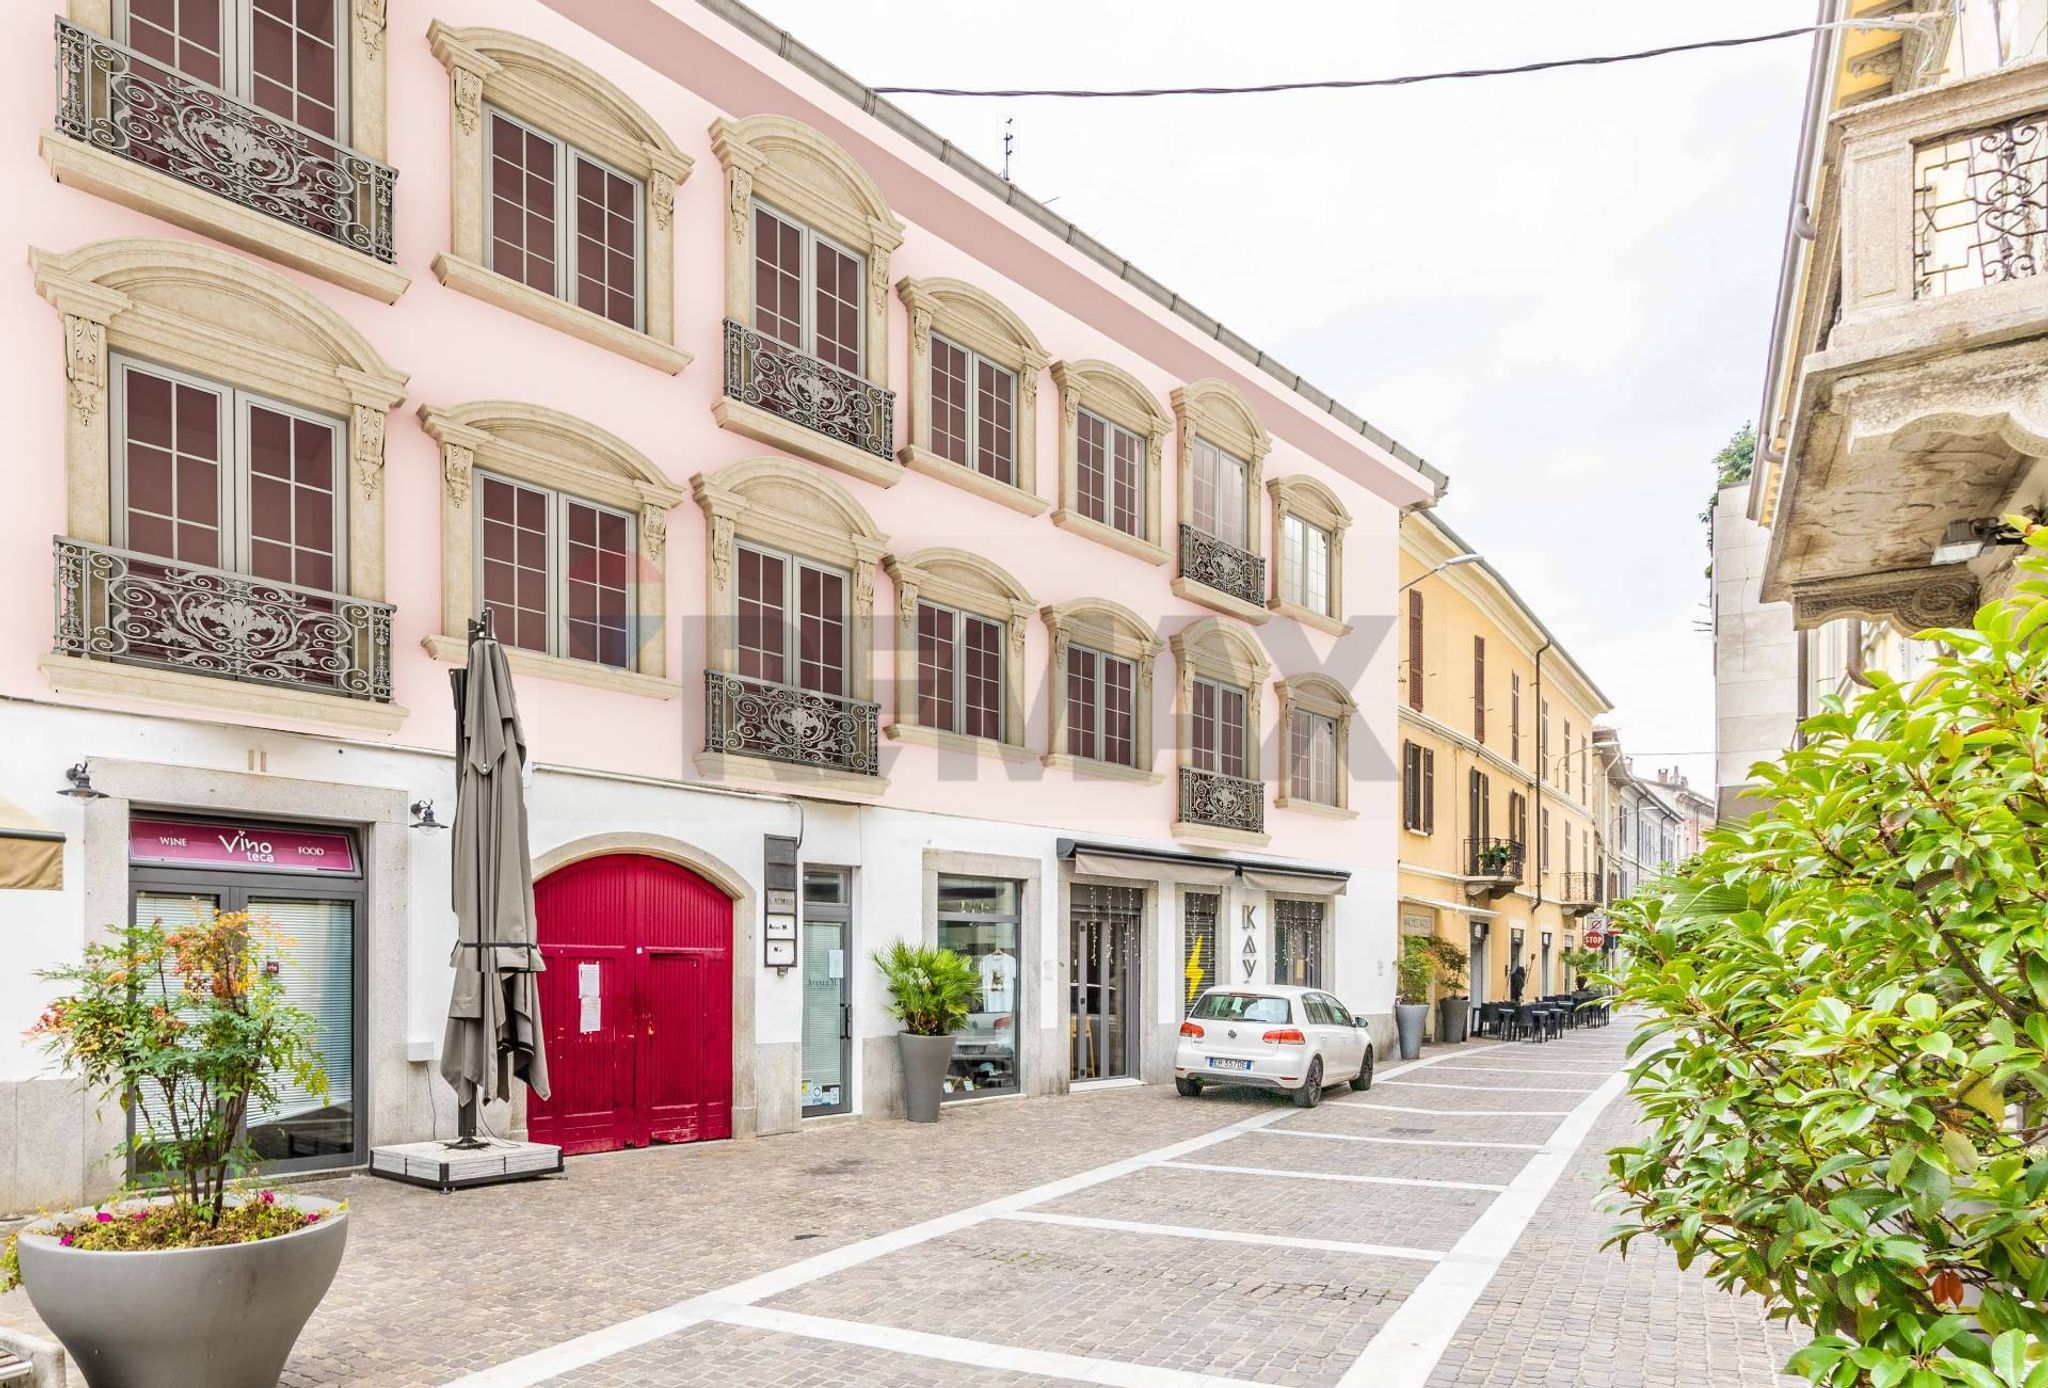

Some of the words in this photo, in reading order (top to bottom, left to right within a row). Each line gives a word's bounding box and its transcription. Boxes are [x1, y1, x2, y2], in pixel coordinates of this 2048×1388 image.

[159, 836, 188, 848] WINE
[218, 830, 273, 854] Vino
[246, 851, 275, 862] teca
[298, 846, 325, 856] FOOD
[1585, 936, 1603, 944] STOP
